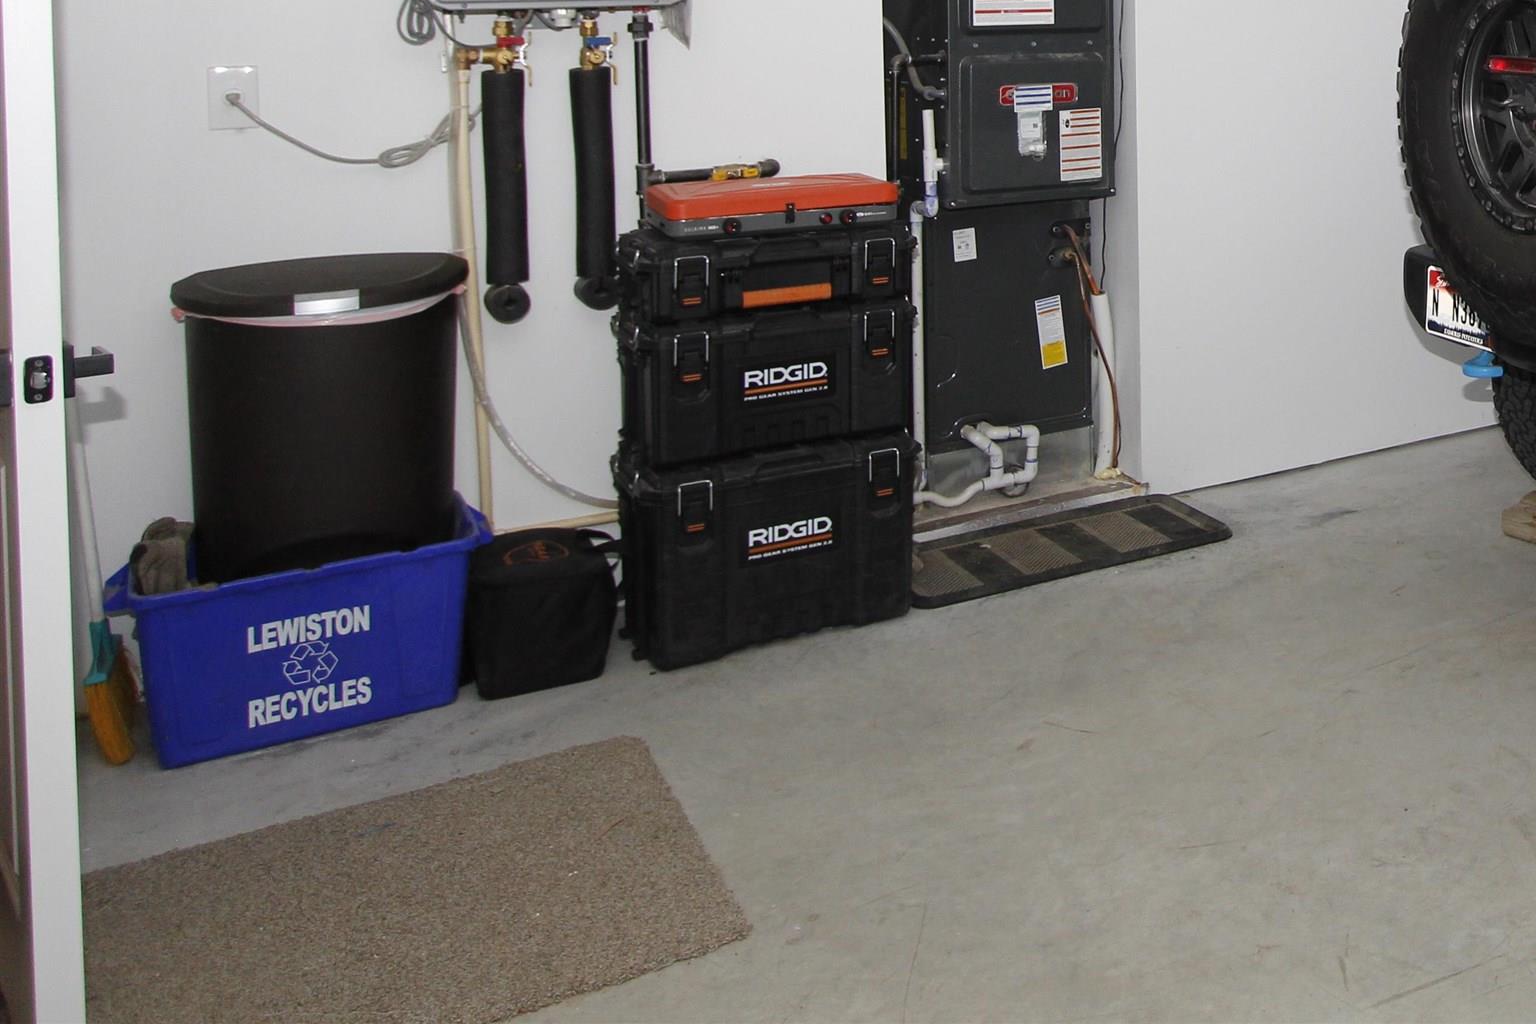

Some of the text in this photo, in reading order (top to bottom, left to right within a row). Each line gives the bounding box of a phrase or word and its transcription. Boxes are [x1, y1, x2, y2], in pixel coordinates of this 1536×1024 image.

[744, 361, 828, 388] RIDGID
[748, 516, 833, 547] RIDGID
[247, 605, 370, 654] LEWISTON
[247, 676, 373, 729] RECYCLES
